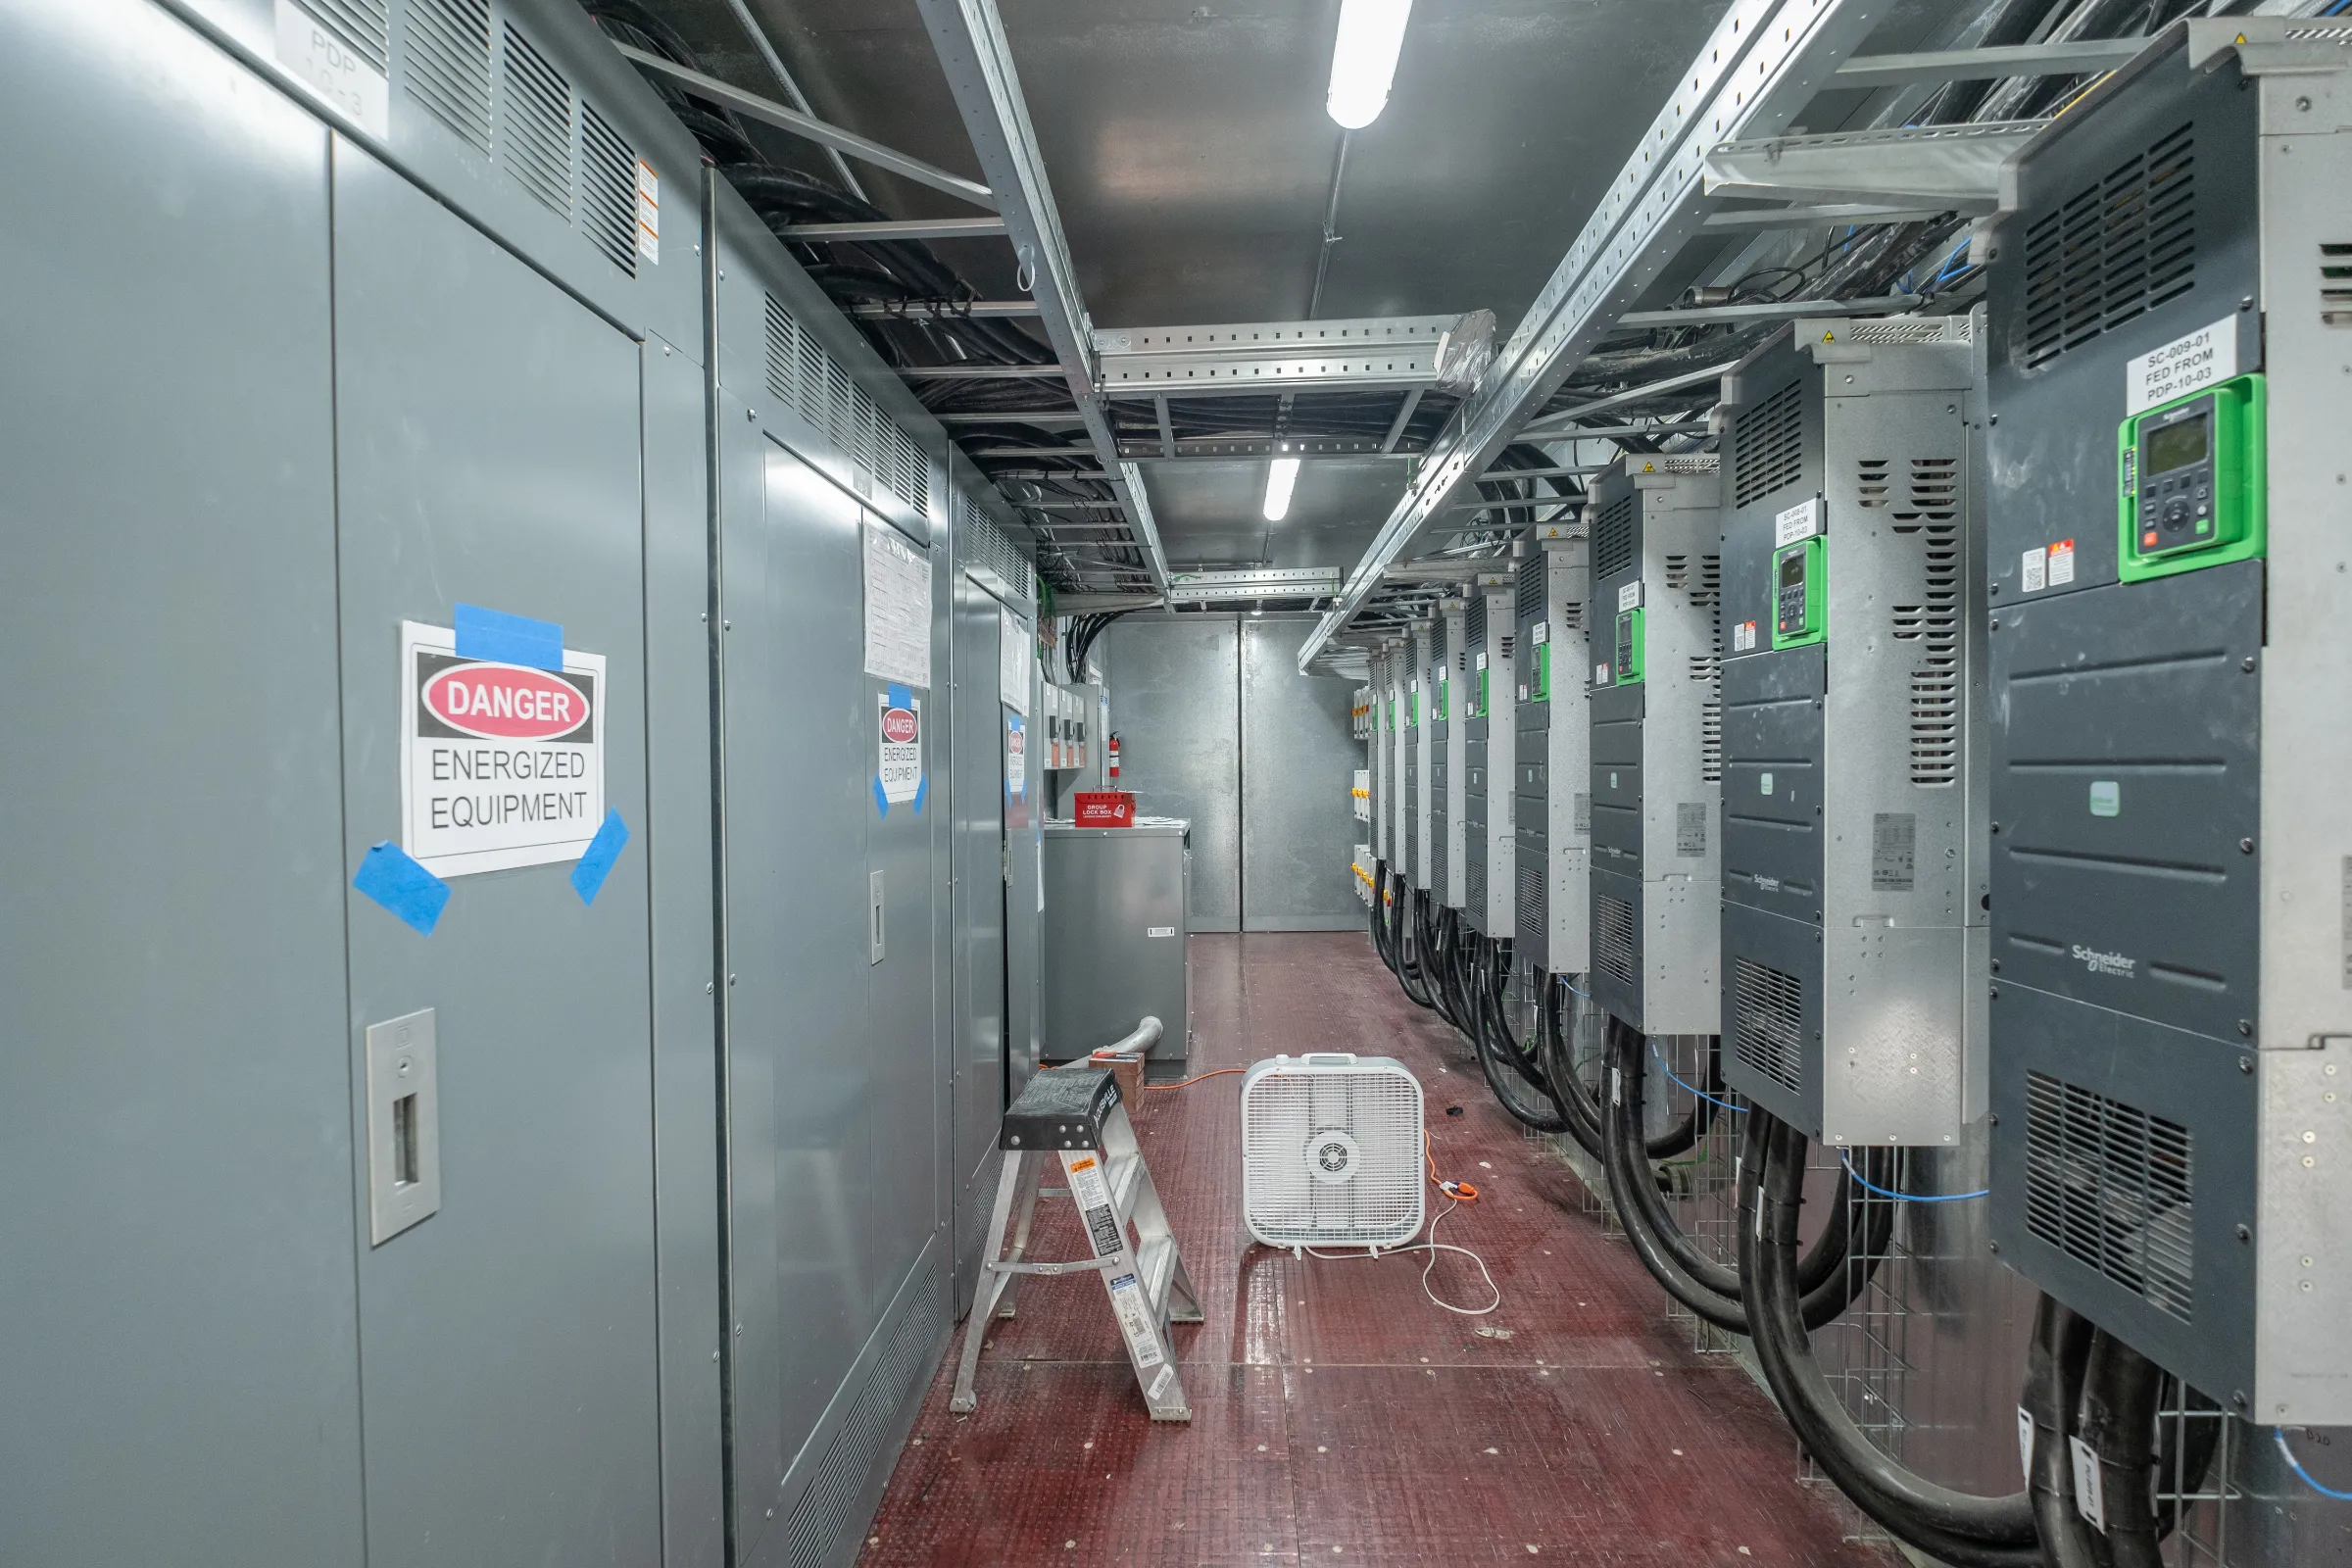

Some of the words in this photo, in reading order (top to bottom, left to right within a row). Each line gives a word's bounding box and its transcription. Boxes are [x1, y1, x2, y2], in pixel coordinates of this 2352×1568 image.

[312, 29, 356, 74] PDP
[2146, 366, 2172, 385] FED
[2174, 347, 2214, 375] FROM
[2147, 332, 2210, 368] SC-009-01
[2147, 367, 2212, 402] PDP-10-03
[1784, 521, 1793, 531] FED
[1793, 515, 1808, 527] FROM
[447, 680, 571, 722] DANGER
[887, 717, 914, 734] DANGER
[432, 749, 585, 781] ENERGIZED
[884, 747, 917, 761] ENERGIZED
[884, 766, 918, 783] EQUIPMENT
[431, 791, 587, 829] EQUIPMENT
[2072, 944, 2135, 969] Schneider
